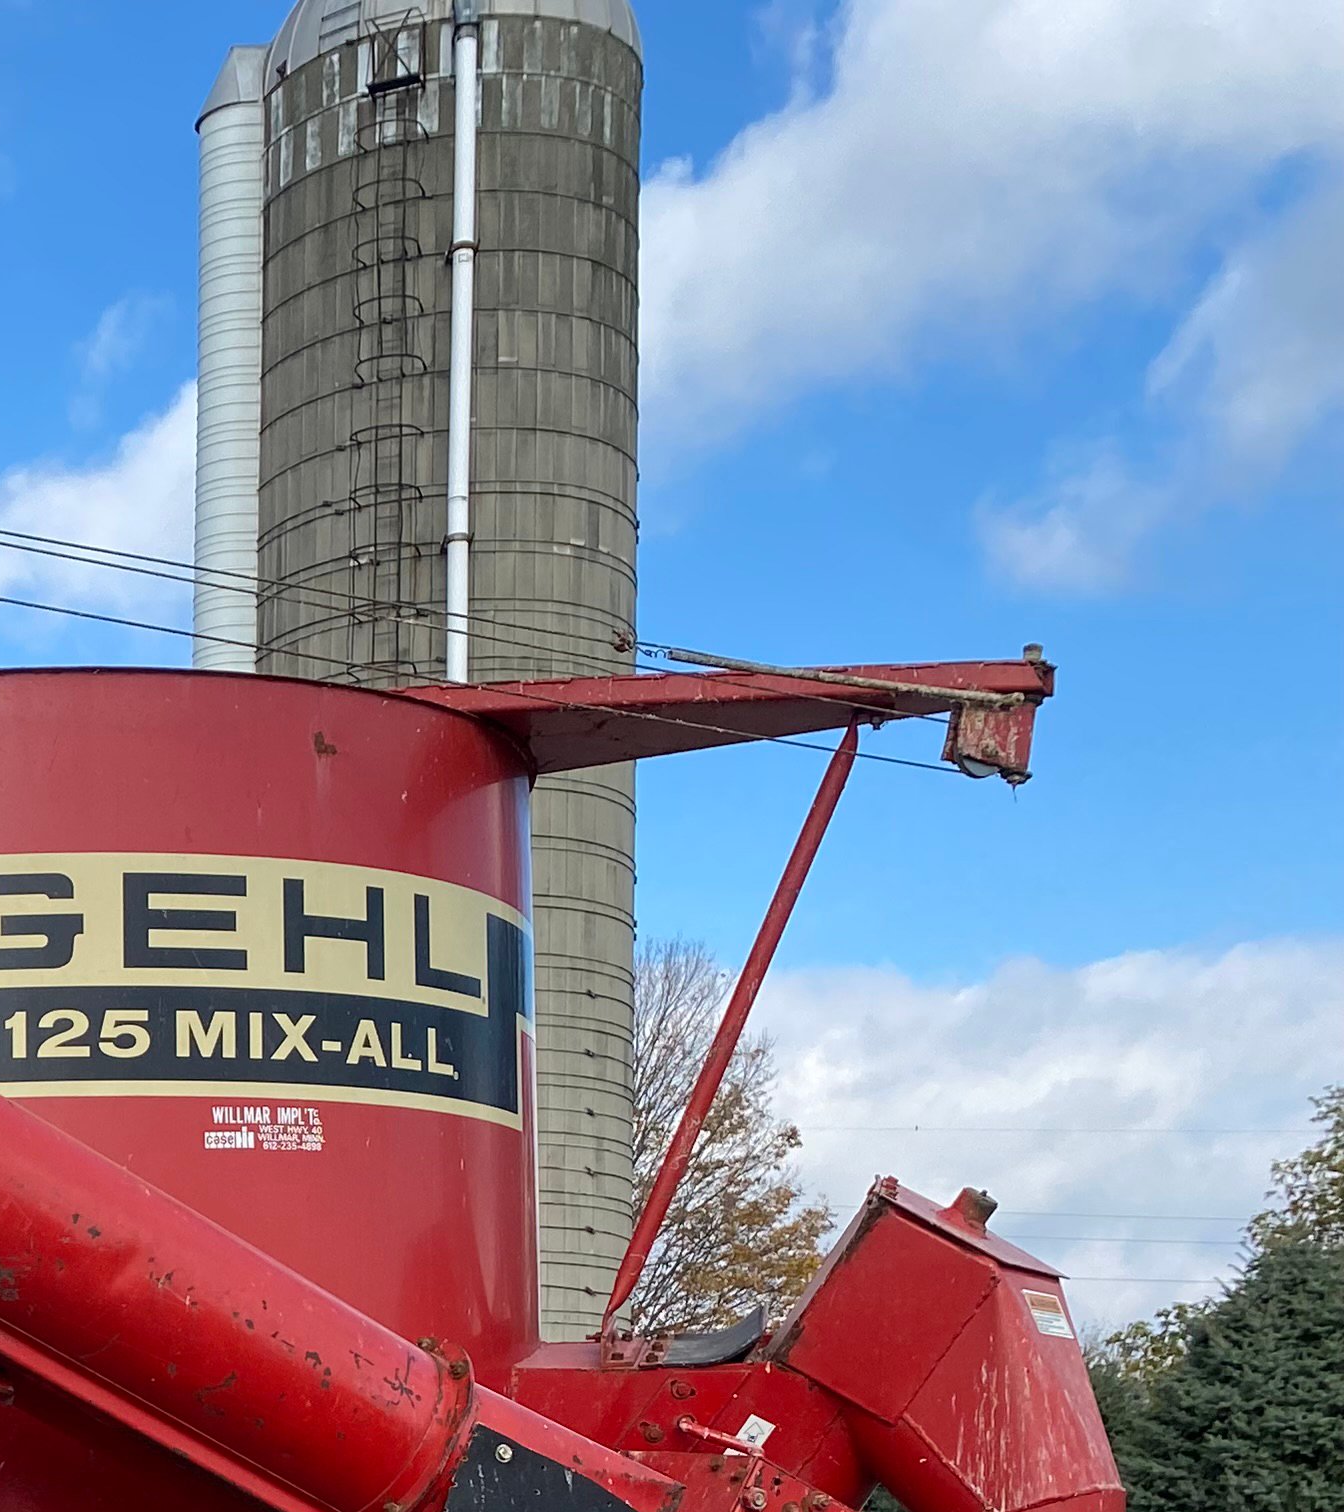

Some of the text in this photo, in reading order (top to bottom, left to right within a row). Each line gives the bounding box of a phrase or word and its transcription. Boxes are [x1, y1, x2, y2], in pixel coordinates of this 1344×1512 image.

[3, 1009, 455, 1076] 125 MIX-ALL
[212, 1106, 271, 1124] WILLMAR
[277, 1107, 314, 1125] IMPL'T
[259, 1125, 284, 1133] WEST
[312, 1126, 323, 1134] 40
[263, 1141, 323, 1151] 612-235-4898
